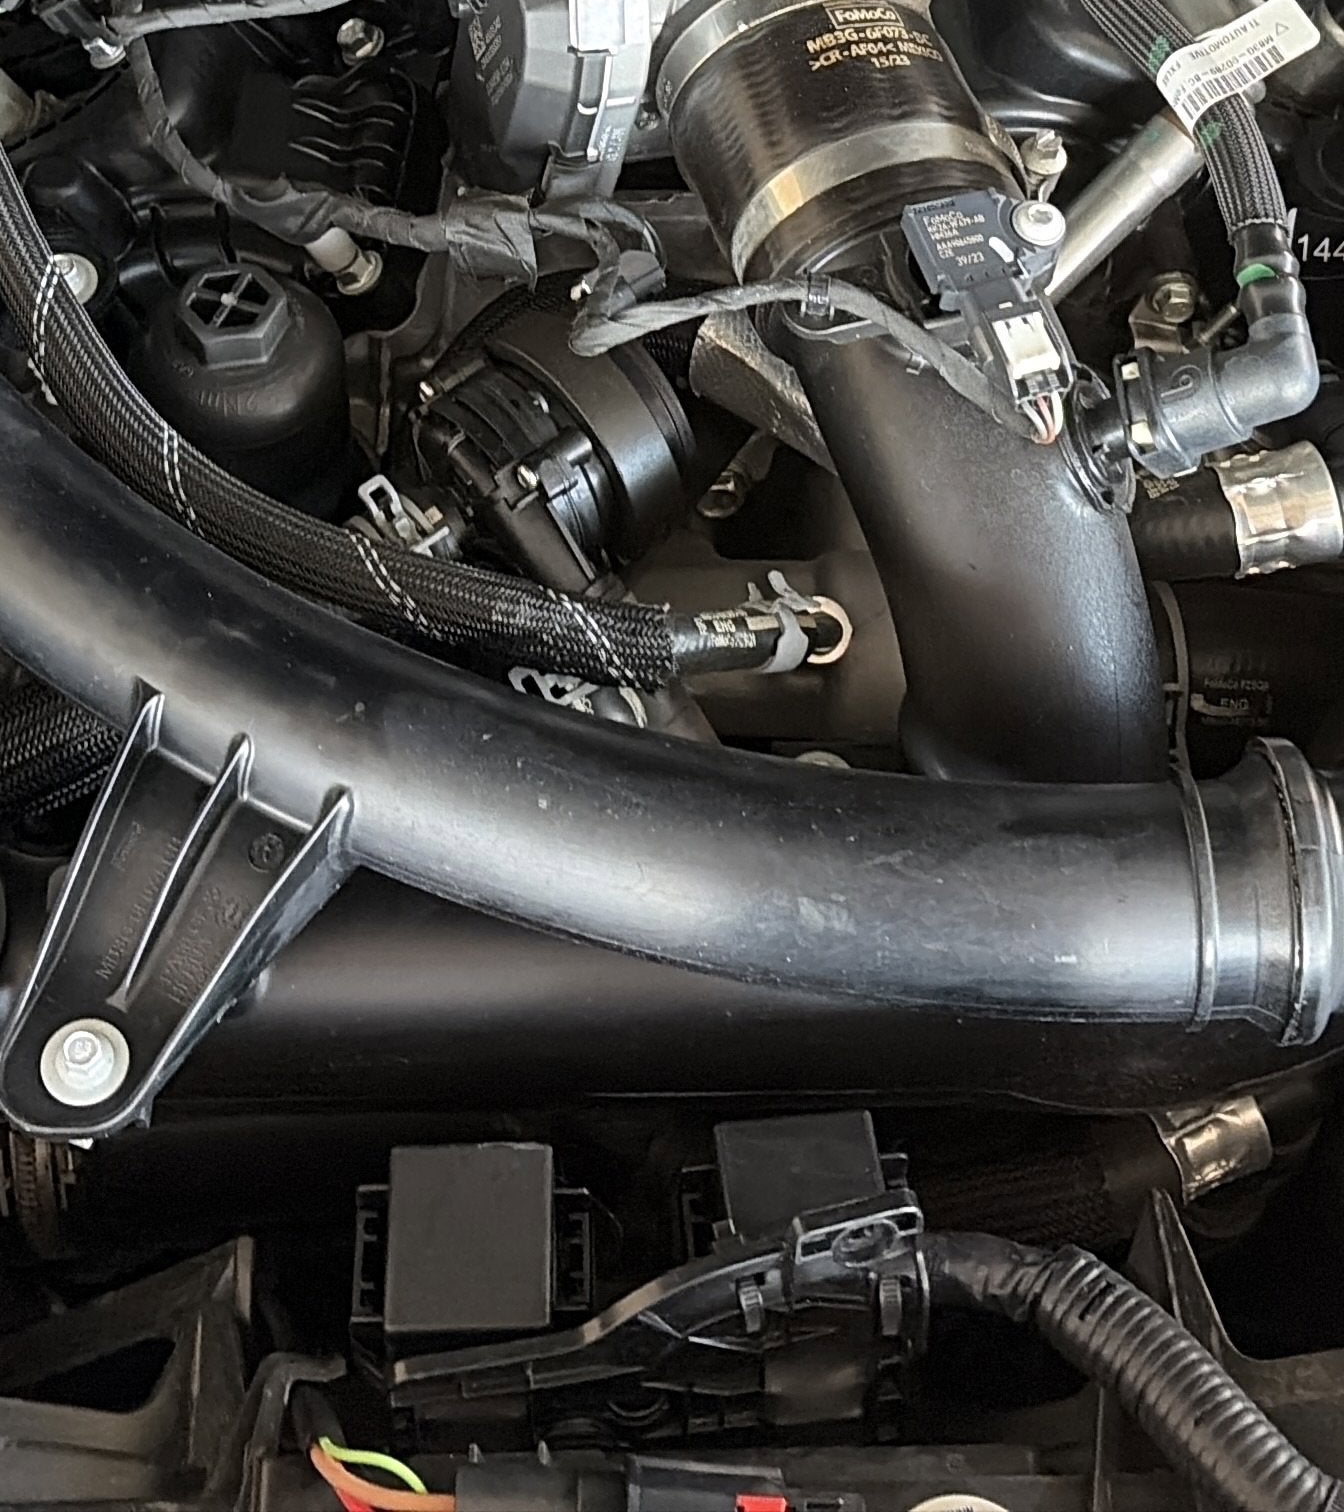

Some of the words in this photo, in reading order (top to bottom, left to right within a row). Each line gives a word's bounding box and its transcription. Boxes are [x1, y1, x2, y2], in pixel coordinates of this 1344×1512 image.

[834, 8, 896, 22] FoMoCo
[1186, 23, 1250, 61] AUTOMOTIVE
[871, 54, 911, 68] 15/23
[922, 208, 963, 227] FoMoCo
[955, 251, 984, 267] 39/23
